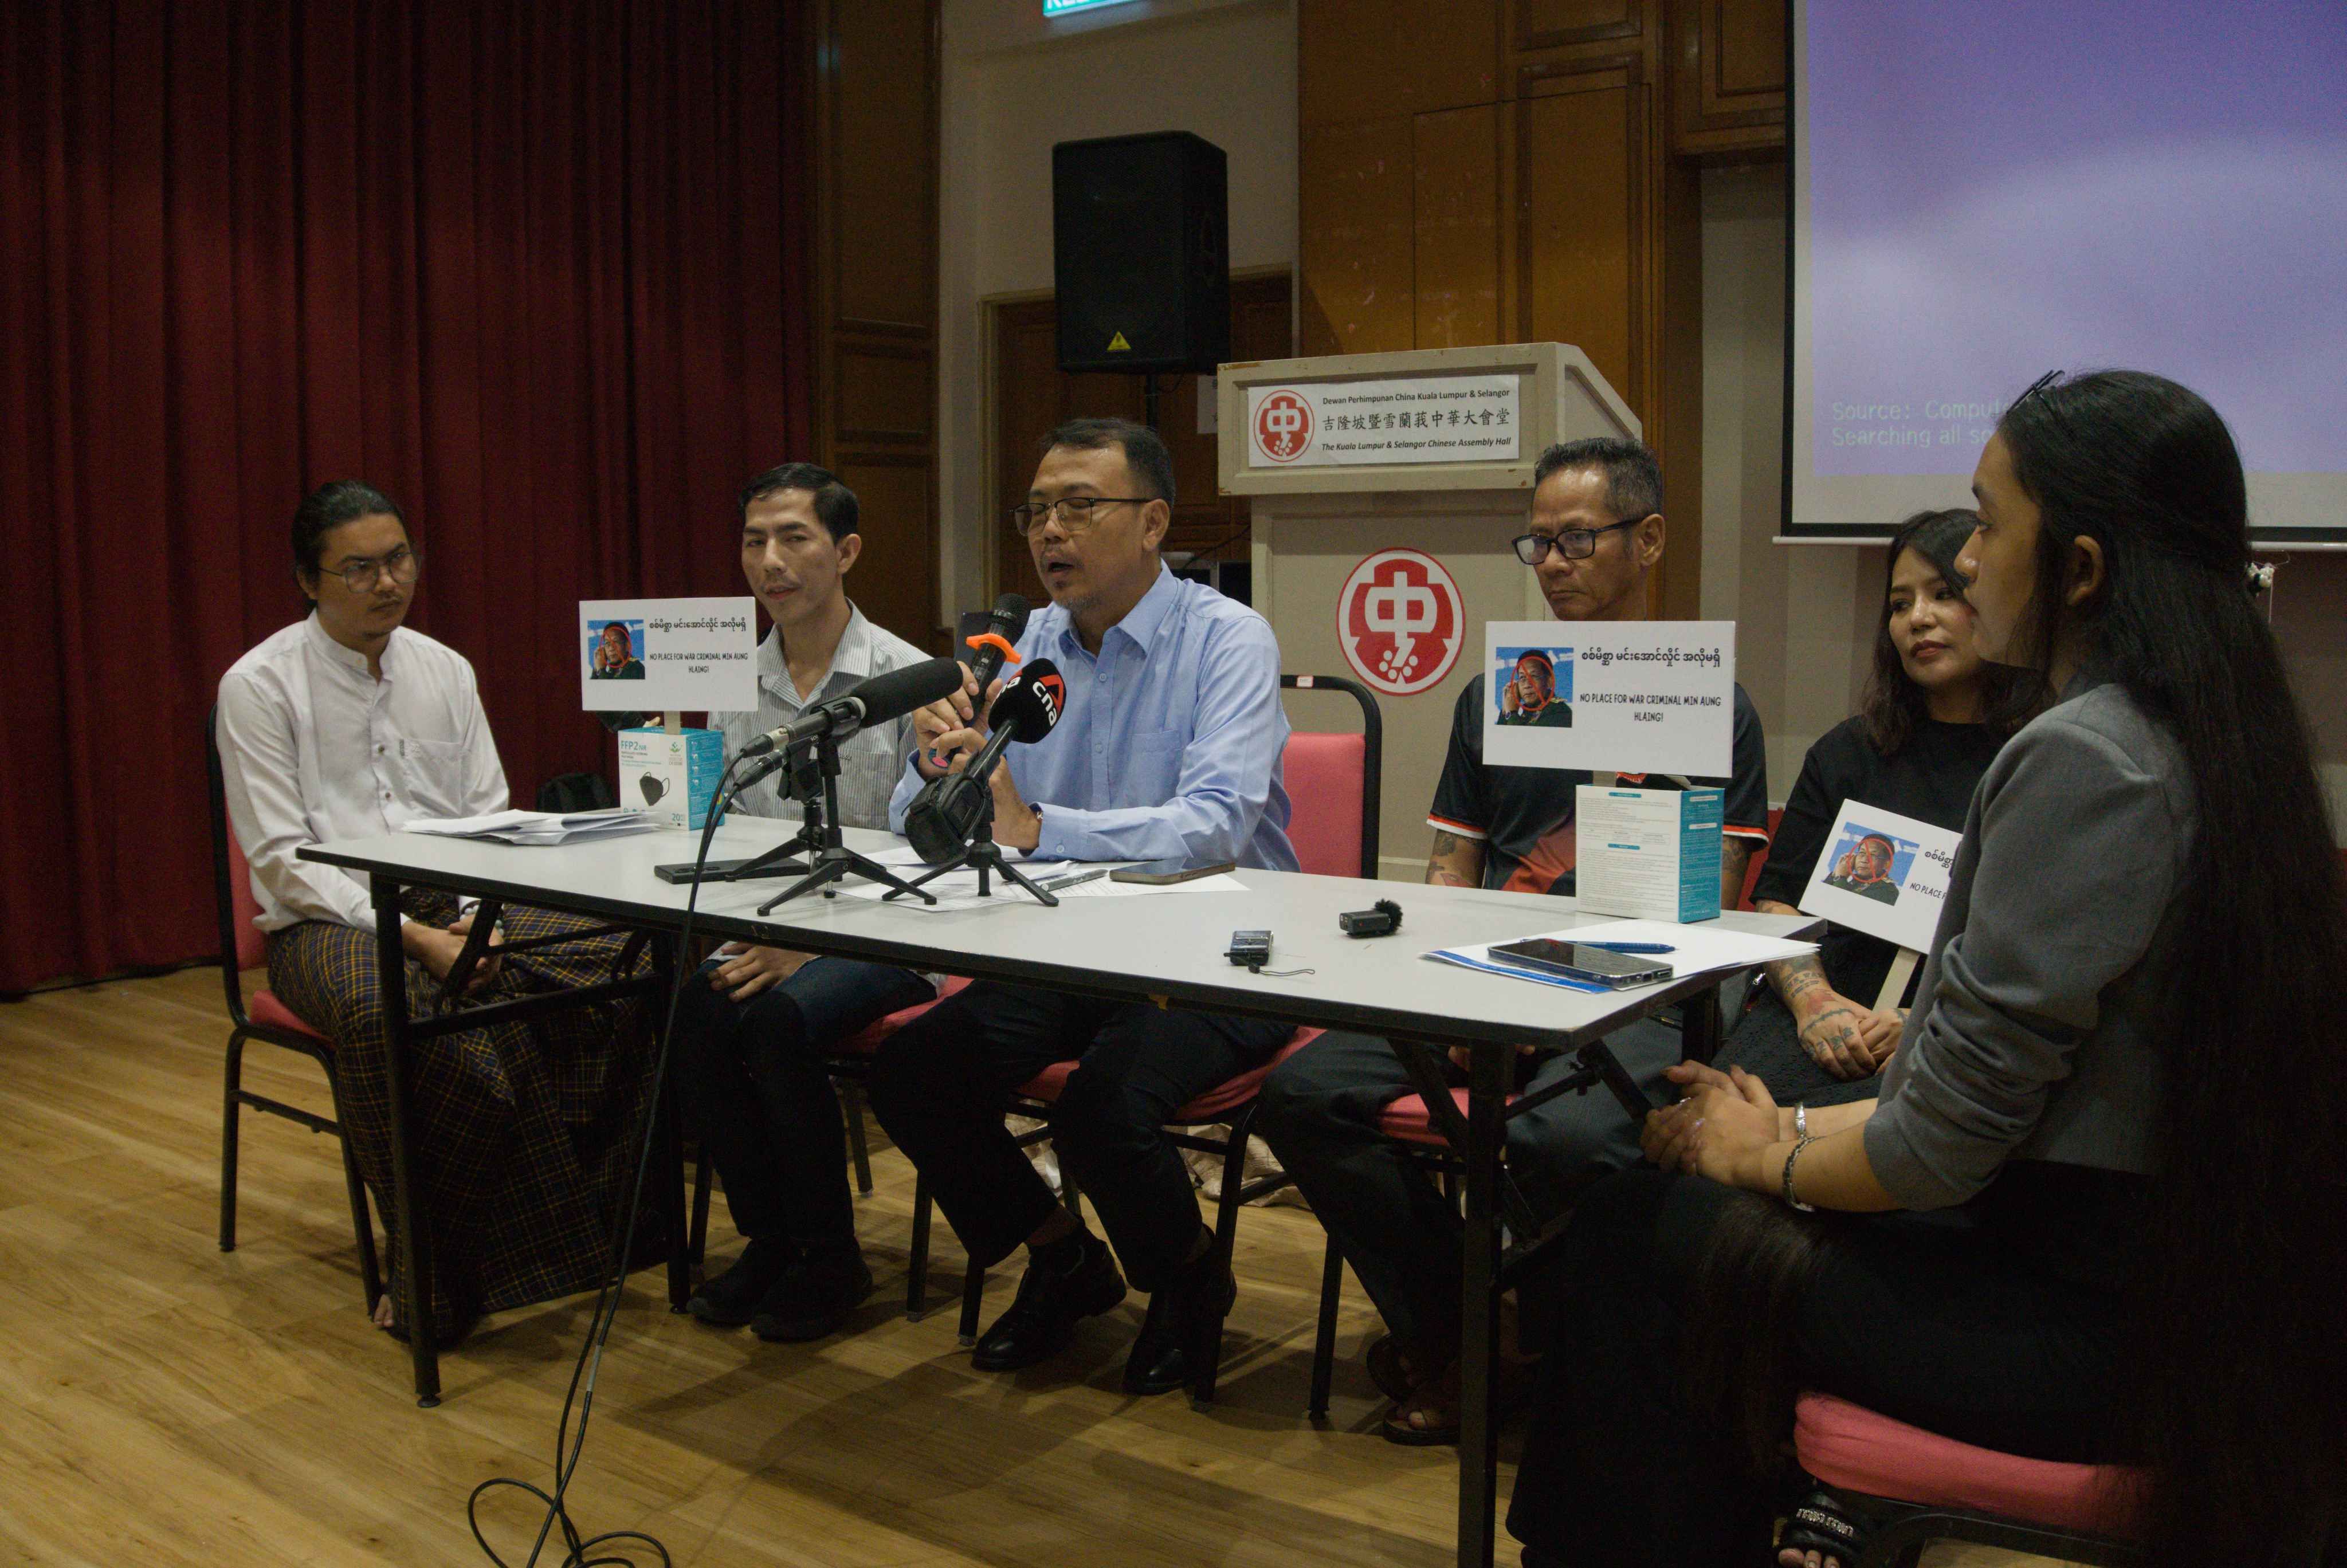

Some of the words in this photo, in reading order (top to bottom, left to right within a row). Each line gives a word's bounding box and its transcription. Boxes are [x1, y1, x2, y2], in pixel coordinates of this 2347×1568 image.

[1348, 395, 1394, 404] Perhimpunan
[1395, 392, 1415, 401] China
[1418, 392, 1437, 400] Kuala
[1439, 391, 1467, 400] Lumpur
[1478, 389, 1510, 398] Selangor
[1834, 401, 1910, 421] Source:
[1322, 407, 1510, 431] 吉隆坡暨雪蘭莪中華大會堂
[1336, 442, 1356, 450] Kuala
[1358, 442, 1385, 450] Lumpur
[1386, 441, 1392, 449] &
[1394, 440, 1426, 450] Selangor
[1428, 439, 1457, 447] Chinese
[1458, 438, 1494, 447] Assembly
[1496, 437, 1511, 445] Hall
[1832, 426, 1930, 449] Searching
[1939, 425, 1960, 446] all
[733, 653, 748, 661] AUNG
[688, 666, 709, 674] HLAING!
[1033, 681, 1057, 726] cna
[1580, 694, 1590, 703] NO
[1592, 694, 1612, 704] PLACE
[1614, 694, 1627, 704] FOR
[1629, 694, 1645, 705] WAR
[1646, 695, 1682, 706] CRIMINAL
[1683, 695, 1698, 706] MIN
[1700, 696, 1721, 706] AUNG
[1634, 712, 1663, 722] HLAING!
[672, 813, 680, 822] 20
[1910, 882, 1921, 891] NO
[1921, 885, 1942, 898] PLACE
